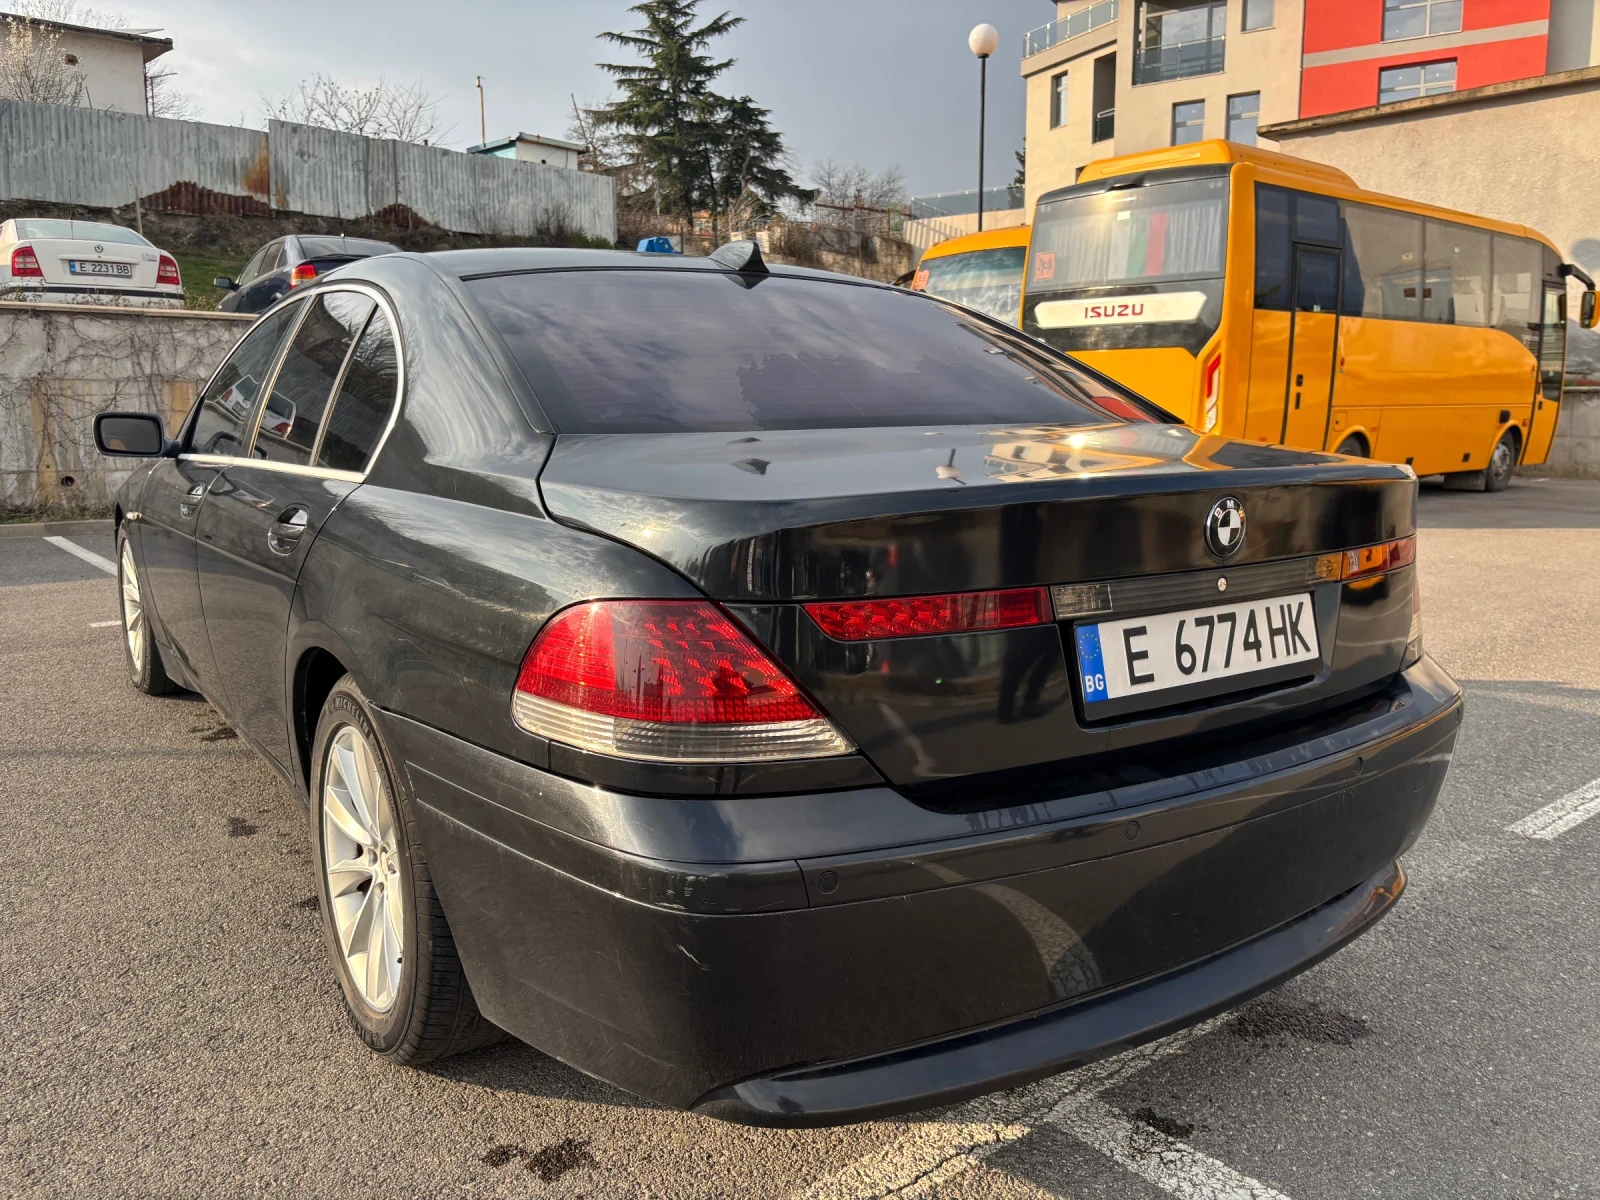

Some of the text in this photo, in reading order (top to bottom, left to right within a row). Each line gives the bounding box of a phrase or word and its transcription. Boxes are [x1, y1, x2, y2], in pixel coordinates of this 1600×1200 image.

[80, 263, 87, 272] E
[1084, 303, 1144, 319] ISUZU
[1123, 625, 1155, 686] E
[1084, 674, 1105, 693] BG
[335, 697, 370, 735] MICHELIN
